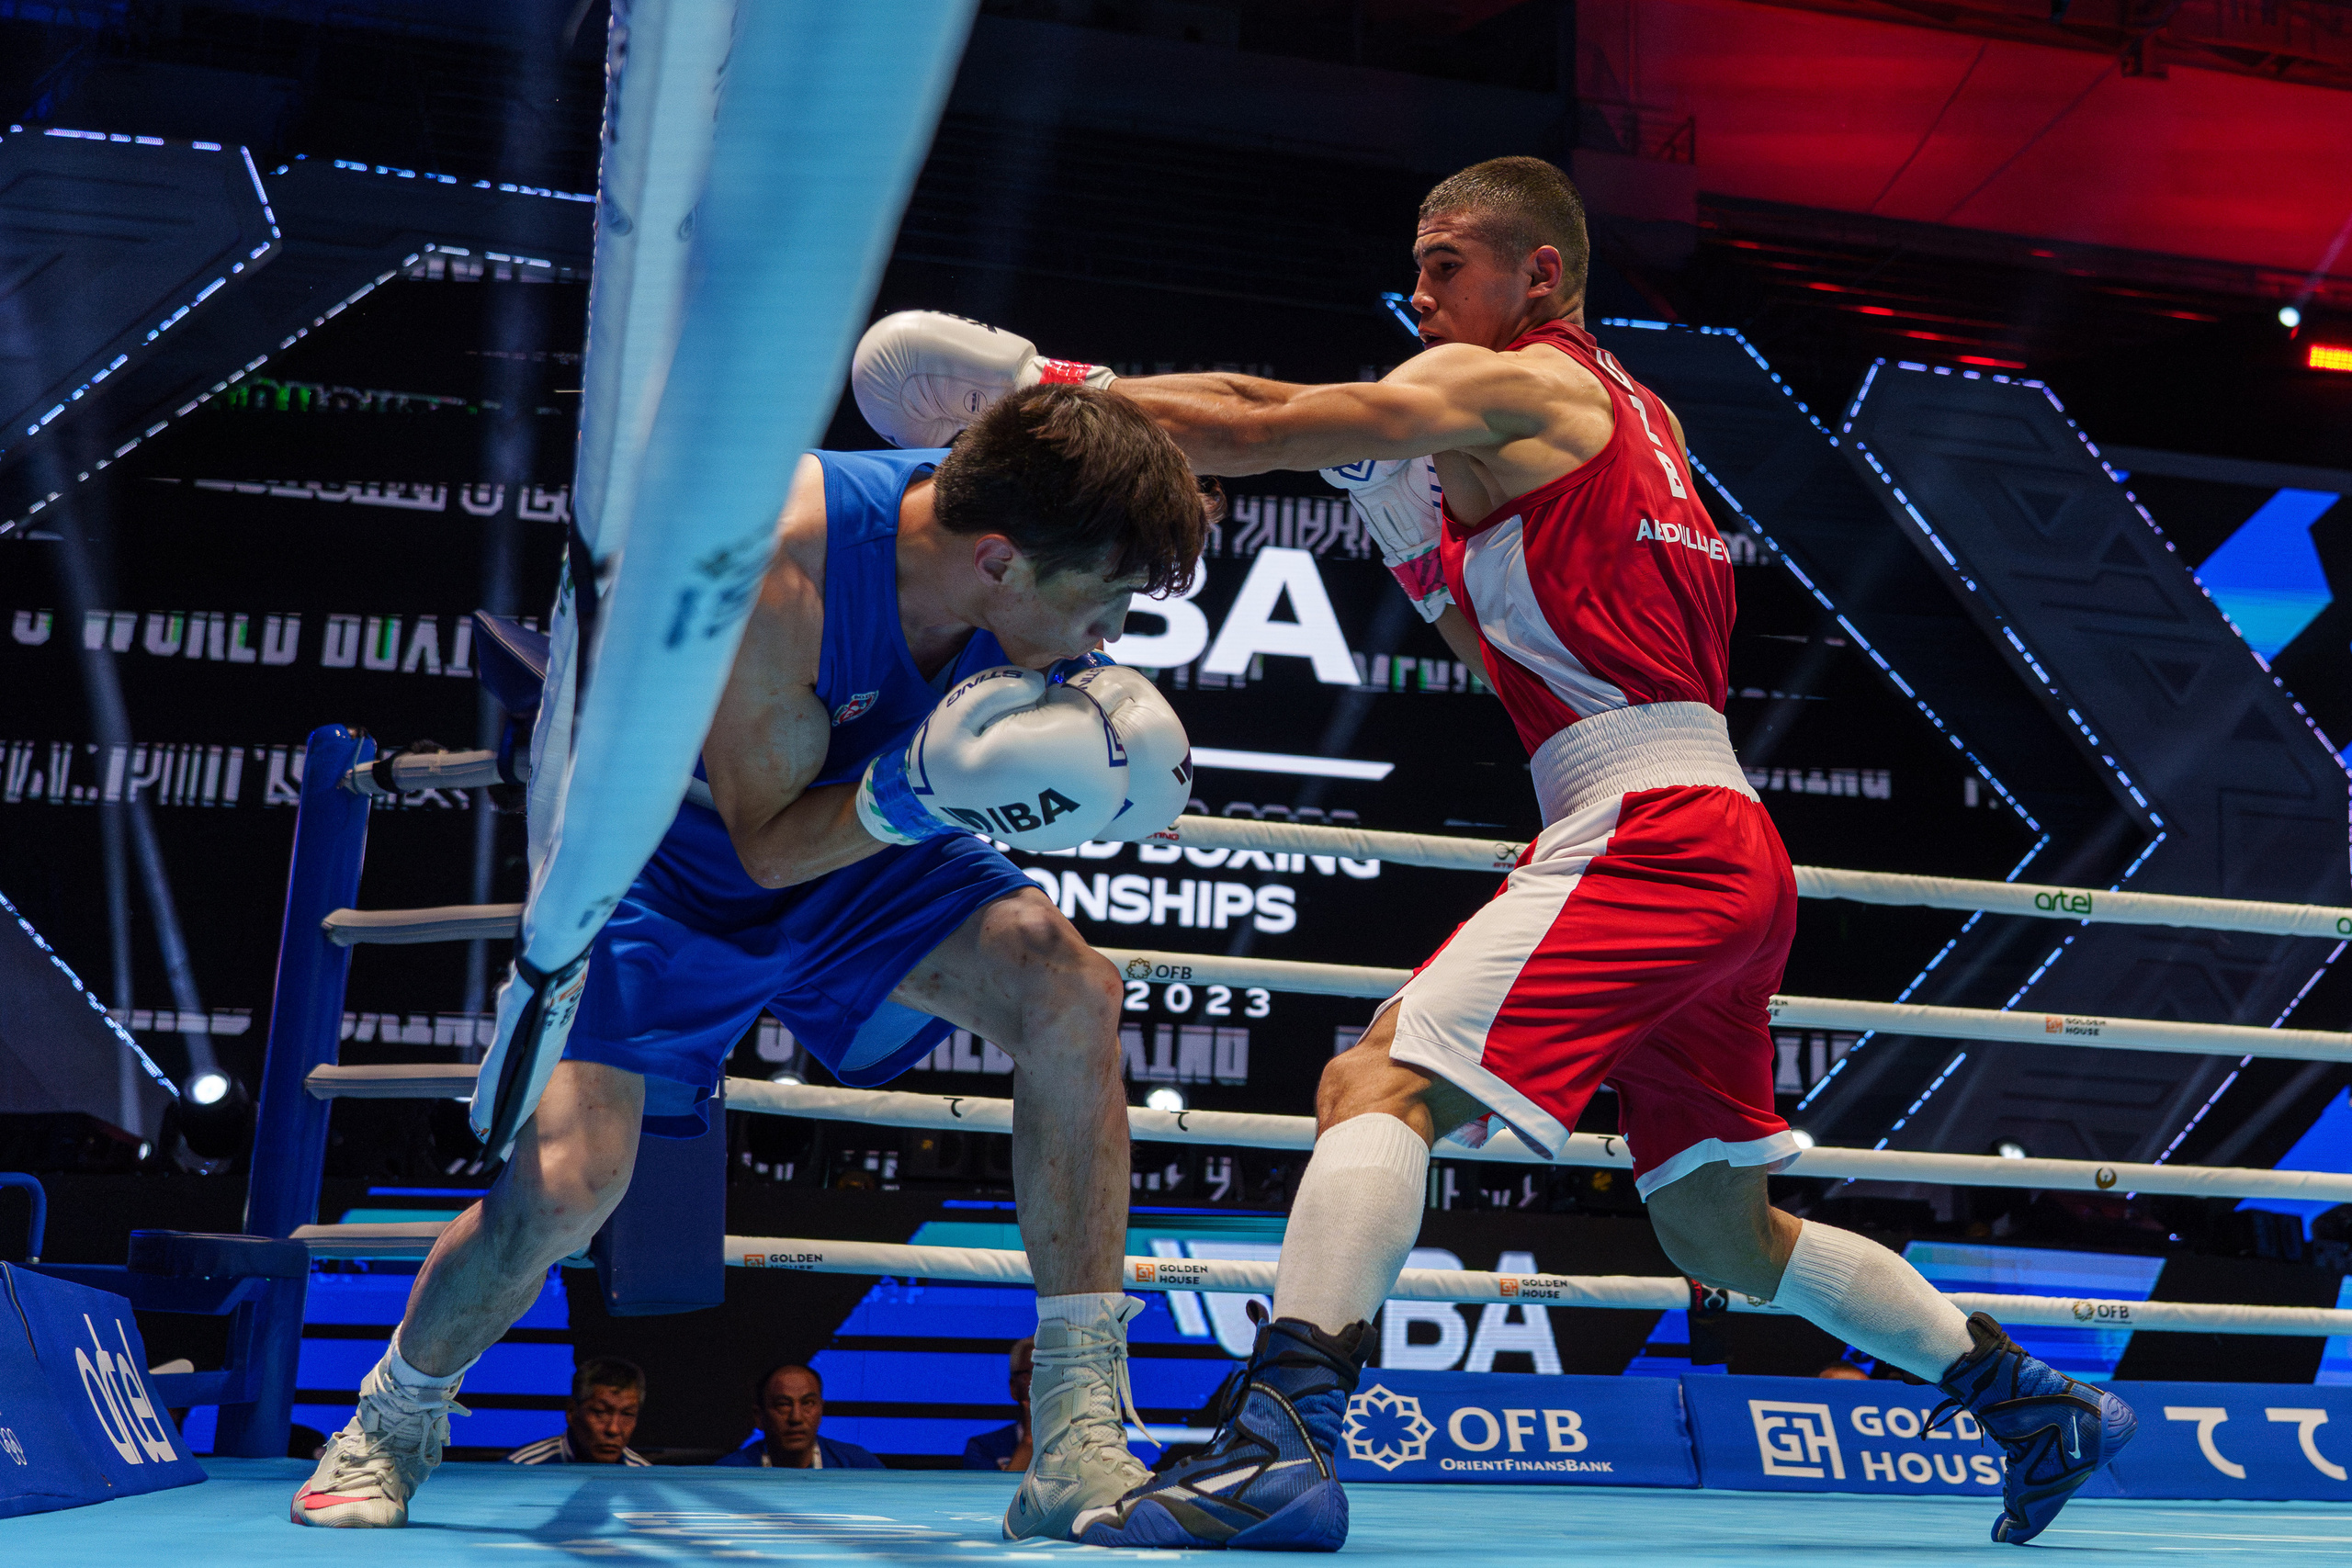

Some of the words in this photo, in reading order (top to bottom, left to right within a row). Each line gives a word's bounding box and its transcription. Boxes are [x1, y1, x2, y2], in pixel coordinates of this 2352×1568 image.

[1596, 349, 1688, 500] UZB
[1102, 547, 1362, 686] BA
[946, 669, 1024, 708] STING
[986, 787, 1081, 834] IBA
[1023, 867, 1297, 934] ONSHIPS
[2035, 889, 2092, 915] artel
[1155, 964, 1193, 980] OFB
[1124, 980, 1272, 1019] 2023
[2064, 1027, 2100, 1036] HOUSE
[770, 1253, 823, 1263] GOLDEN
[1159, 1264, 1209, 1273] GOLDEN
[1159, 1275, 1200, 1285] HOUSE
[1521, 1279, 1568, 1288] GOLDEN
[1521, 1289, 1561, 1299] HOUSE
[1380, 1246, 1565, 1376] BA
[2098, 1304, 2130, 1319] OFB
[1447, 1406, 1589, 1453] OFB
[1850, 1405, 1986, 1440] GOLD
[1860, 1450, 2008, 1485] HOUS
